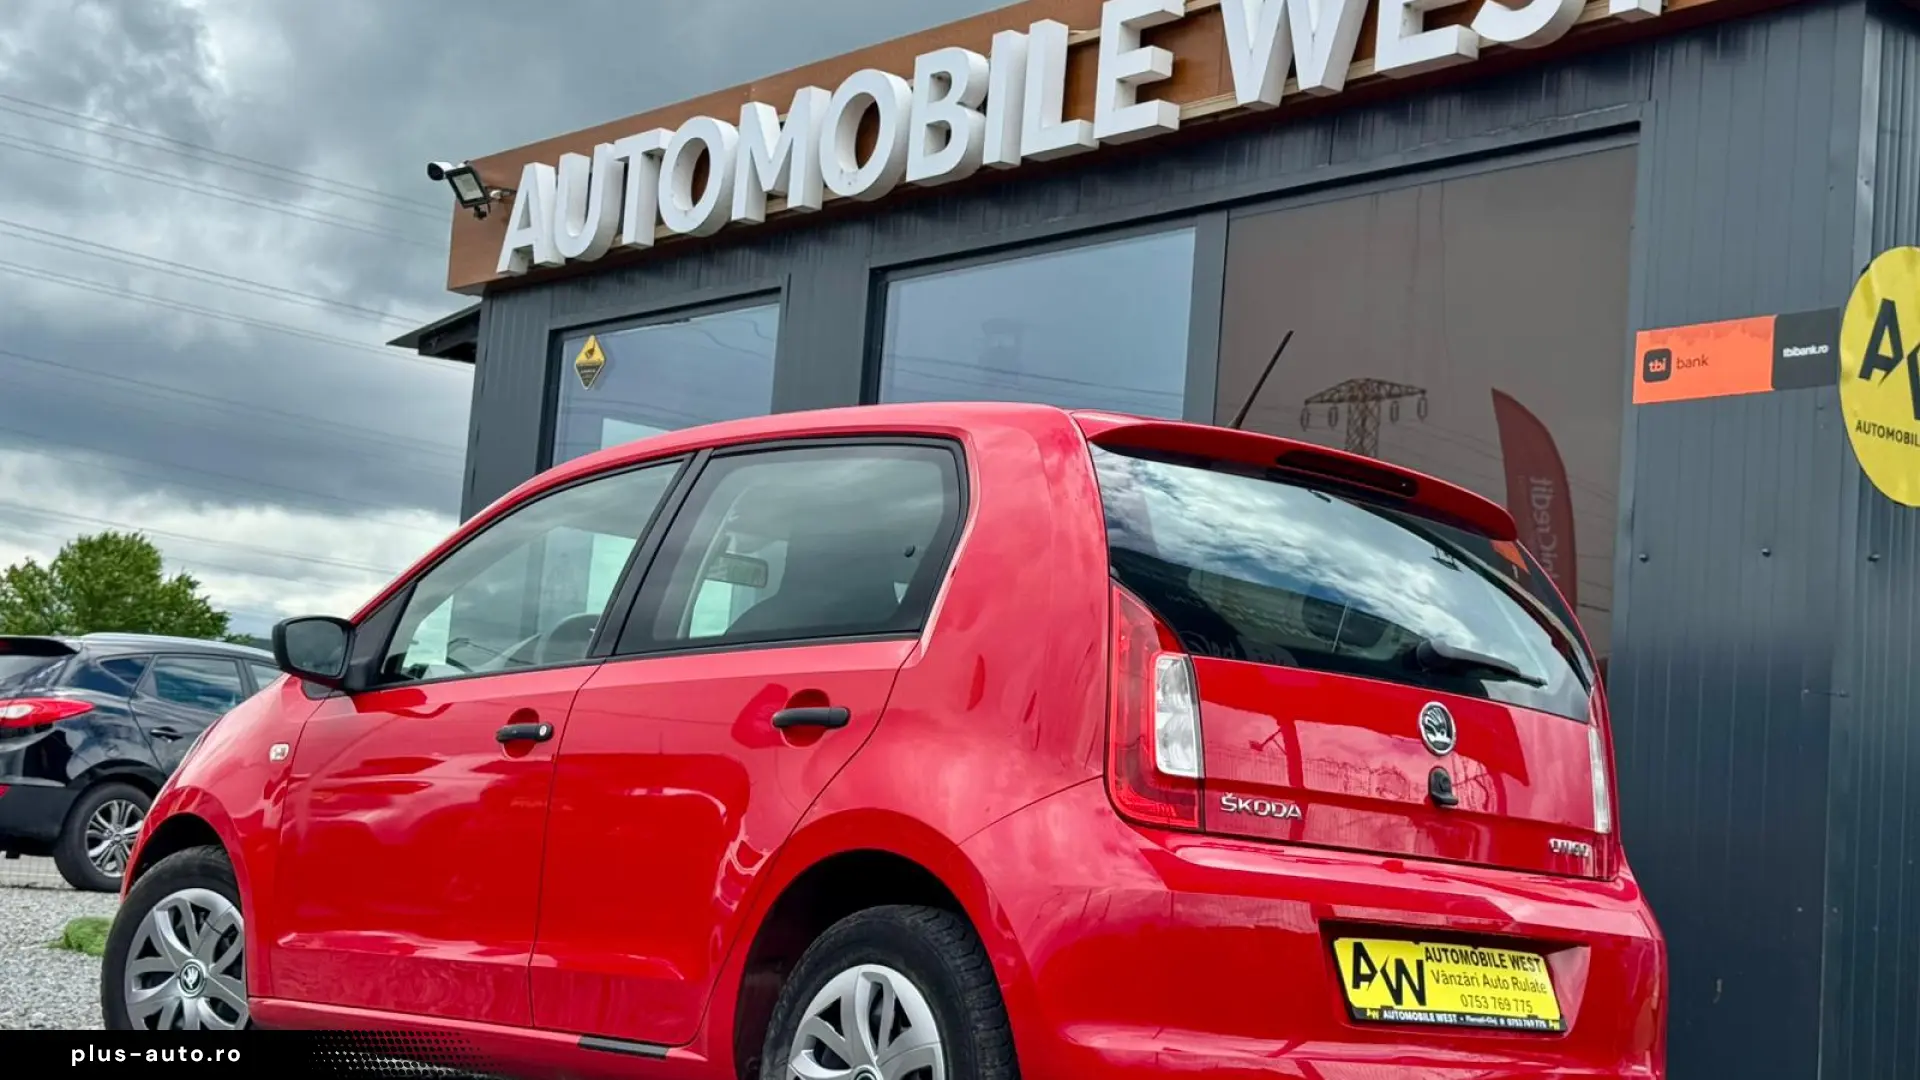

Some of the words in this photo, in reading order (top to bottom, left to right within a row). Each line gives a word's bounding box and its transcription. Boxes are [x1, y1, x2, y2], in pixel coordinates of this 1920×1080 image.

[496, 0, 1184, 276] AUTOMOBILE
[1222, 0, 1662, 108] WE
[1782, 344, 1830, 358] tbibank.ro
[1858, 298, 1920, 421] A
[1648, 358, 1667, 373] tbi
[1676, 354, 1710, 370] bank
[1220, 792, 1303, 820] ŠKODA
[1424, 946, 1508, 969] AUTOMOBILE
[1508, 956, 1542, 973] WEST
[1482, 973, 1510, 990] Auto
[1511, 976, 1548, 995] Rulate
[1460, 993, 1490, 1010] 0753
[1491, 995, 1512, 1012] 769
[1513, 998, 1534, 1014] 775
[1383, 1009, 1435, 1022] AUTOMOBILE
[1435, 1013, 1458, 1023] WEST
